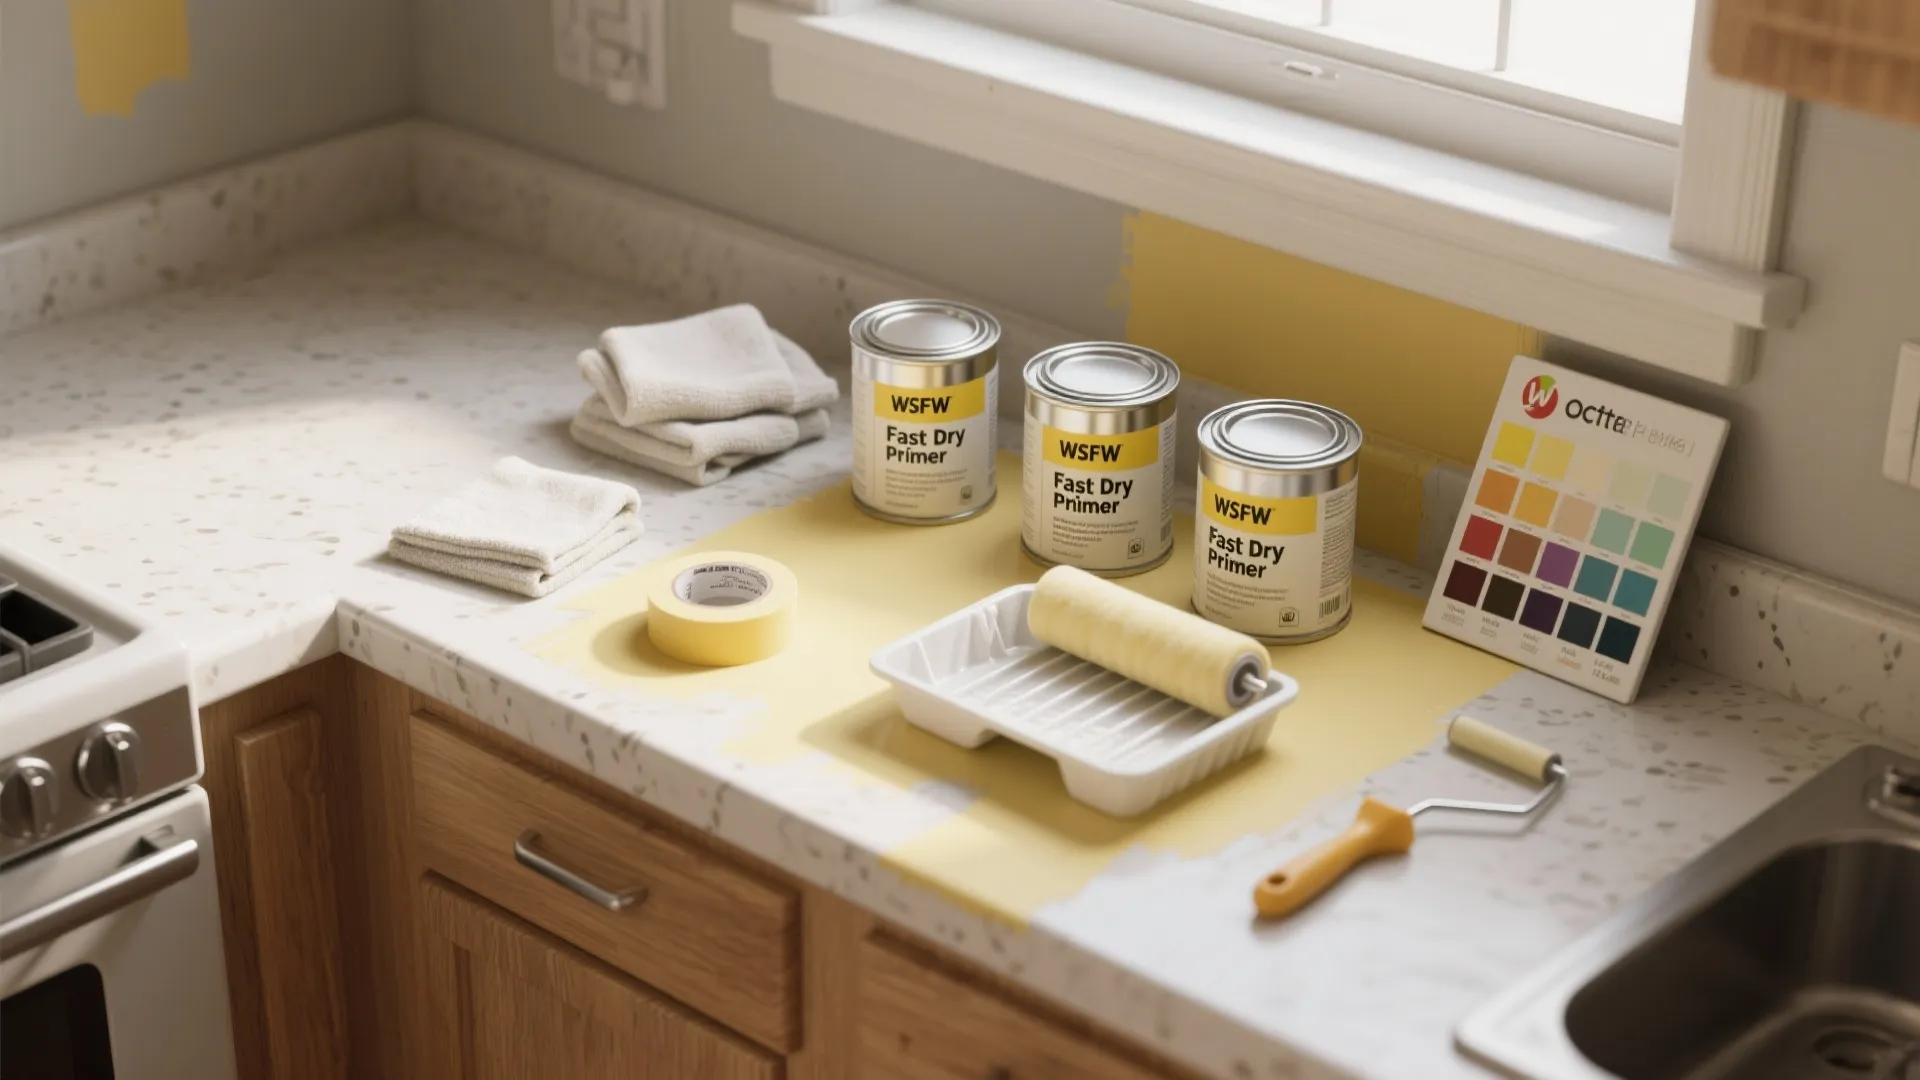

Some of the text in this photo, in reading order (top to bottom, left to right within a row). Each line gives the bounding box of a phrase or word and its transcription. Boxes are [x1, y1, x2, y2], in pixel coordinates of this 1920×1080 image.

[891, 395, 950, 414] WSFW
[886, 425, 965, 447] Fast Dry
[886, 446, 947, 464] Primer
[1059, 439, 1121, 462] WSFW
[1053, 471, 1133, 499] Fast Dry
[1214, 493, 1272, 525] WSFW
[1208, 526, 1285, 565] Fast Dry
[1208, 547, 1267, 579] Primer
